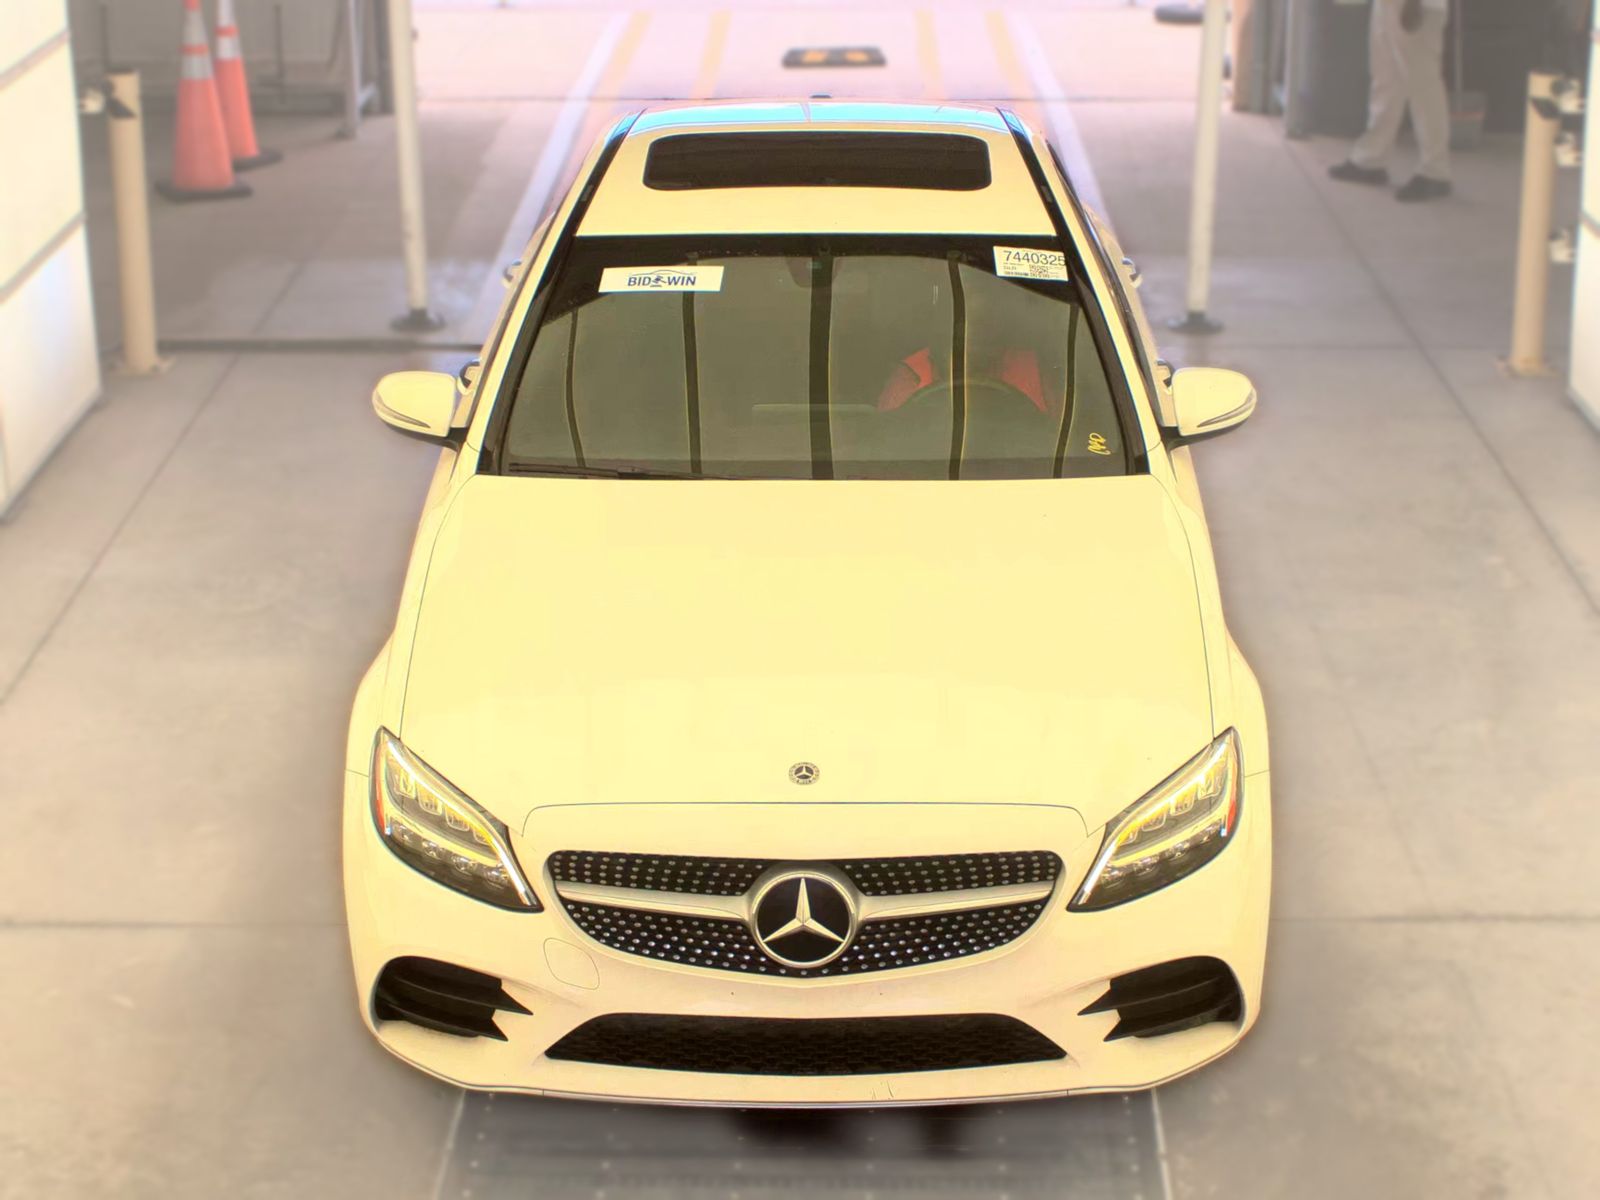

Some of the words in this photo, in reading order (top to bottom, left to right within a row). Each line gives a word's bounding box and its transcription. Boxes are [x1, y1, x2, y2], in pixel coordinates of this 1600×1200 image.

[1003, 250, 1066, 266] 7440325
[627, 276, 651, 286] BID
[667, 276, 696, 286] WIN
